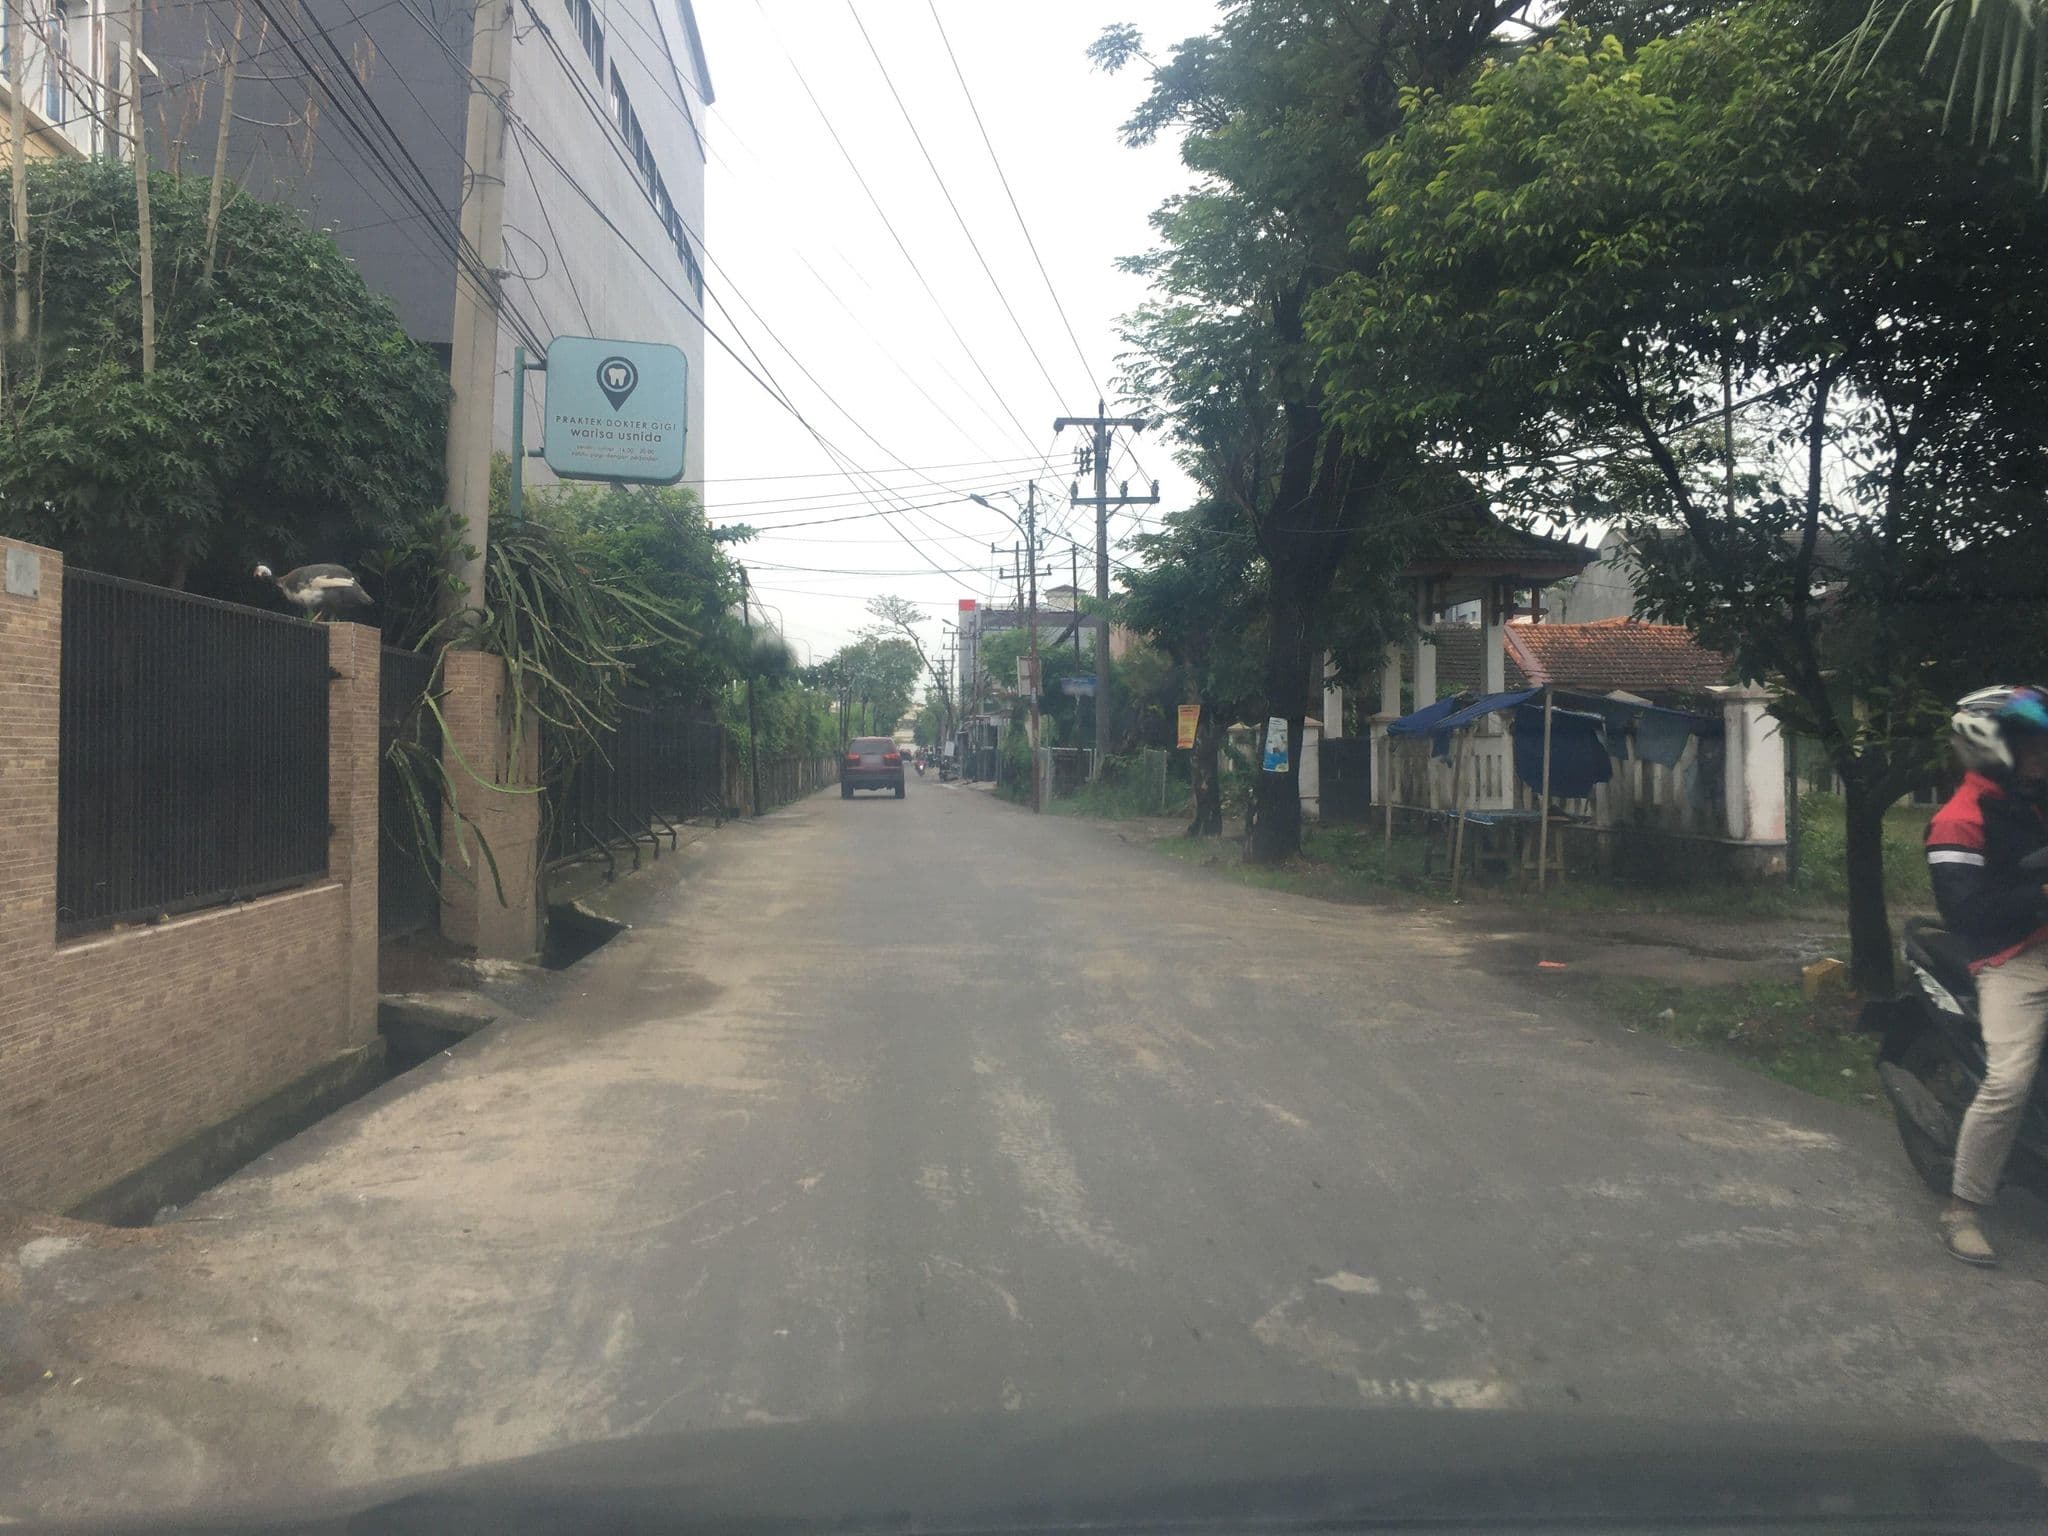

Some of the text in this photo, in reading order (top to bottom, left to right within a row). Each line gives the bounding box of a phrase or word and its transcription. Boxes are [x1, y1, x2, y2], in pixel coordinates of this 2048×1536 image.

[555, 415, 676, 431] PRAKTEK DOKTER GIGI
[570, 428, 662, 442] warisa usnida
